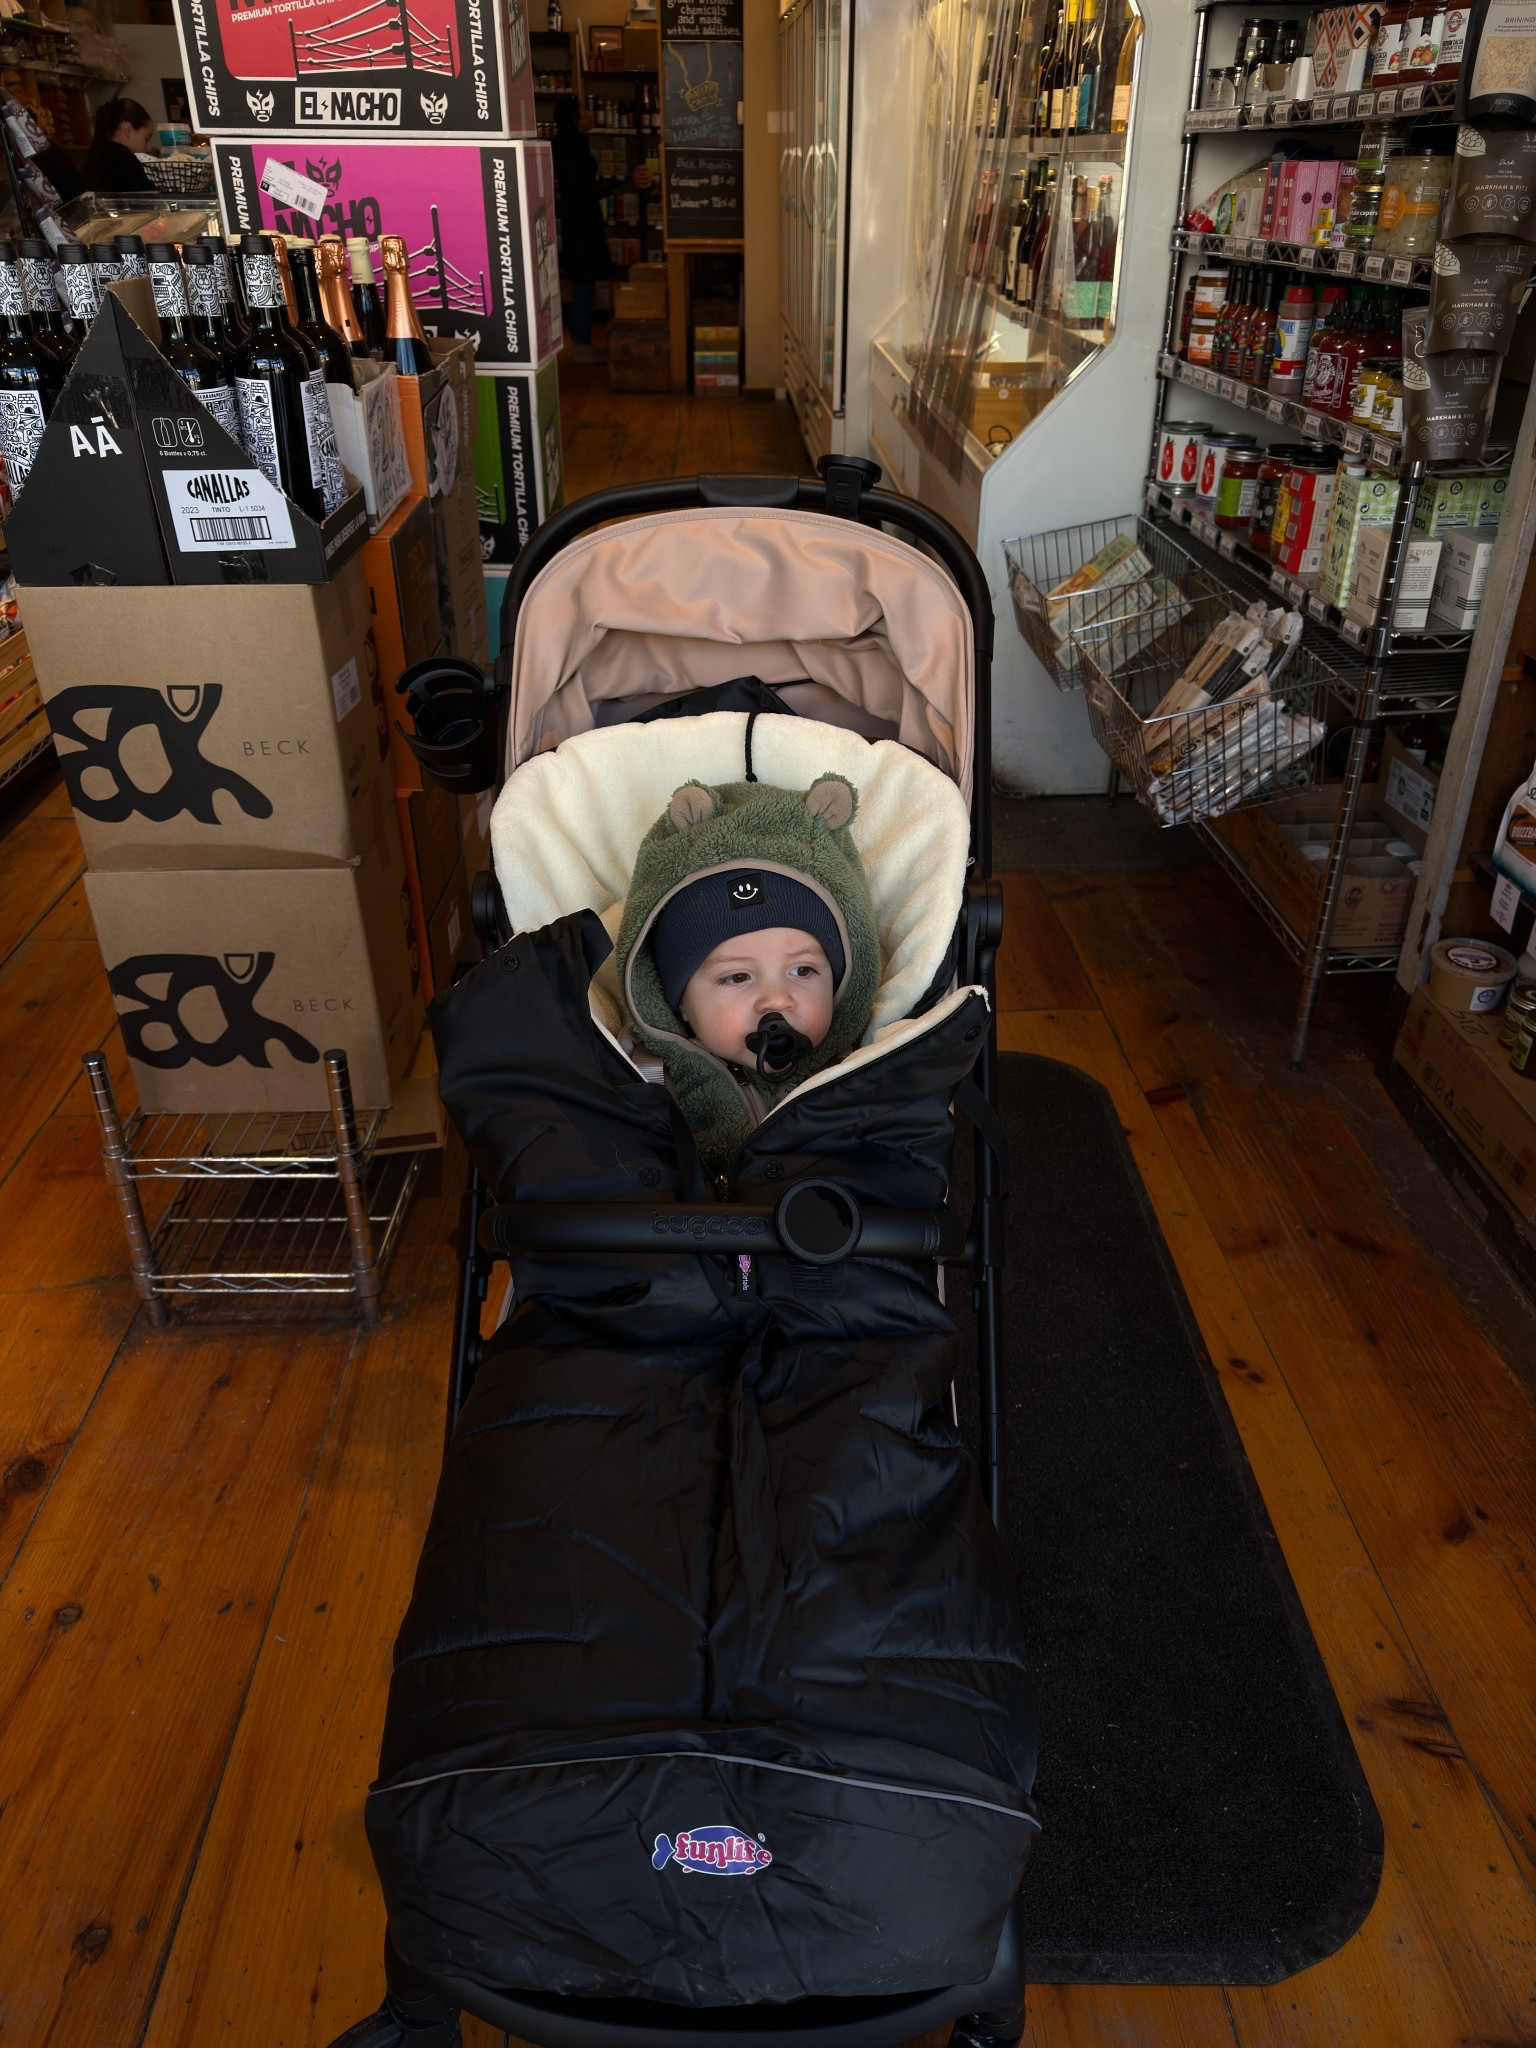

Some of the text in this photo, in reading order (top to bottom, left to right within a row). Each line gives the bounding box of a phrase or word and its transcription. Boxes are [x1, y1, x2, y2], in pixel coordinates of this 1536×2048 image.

[231, 7, 272, 22] PREMIUM
[272, 0, 315, 14] TORTILLA
[678, 14, 723, 24] and made
[680, 4, 728, 16] chemicals
[1504, 16, 1536, 24] BRINING
[666, 24, 740, 36] without additives
[190, 0, 220, 118] ORTILLA CHIPS
[467, 0, 490, 121] ORTILLA CHIPS
[301, 90, 398, 122] EL NACHO
[1364, 143, 1380, 151] capers
[229, 156, 250, 230] PREMIUM
[492, 158, 519, 354] PREMIUM TORTILLA CHIPS
[506, 386, 530, 551] PREMIUM TORTILLA CHIP
[187, 473, 250, 504] CANALLAS
[181, 506, 199, 514] 2023
[1337, 492, 1356, 513] BROTH
[1416, 494, 1434, 512] OTH
[1414, 517, 1426, 530] ETO
[243, 739, 310, 756] BECK
[293, 998, 354, 1012] BECK
[652, 1212, 769, 1241] bugaboo
[675, 1832, 772, 1868] funlife
